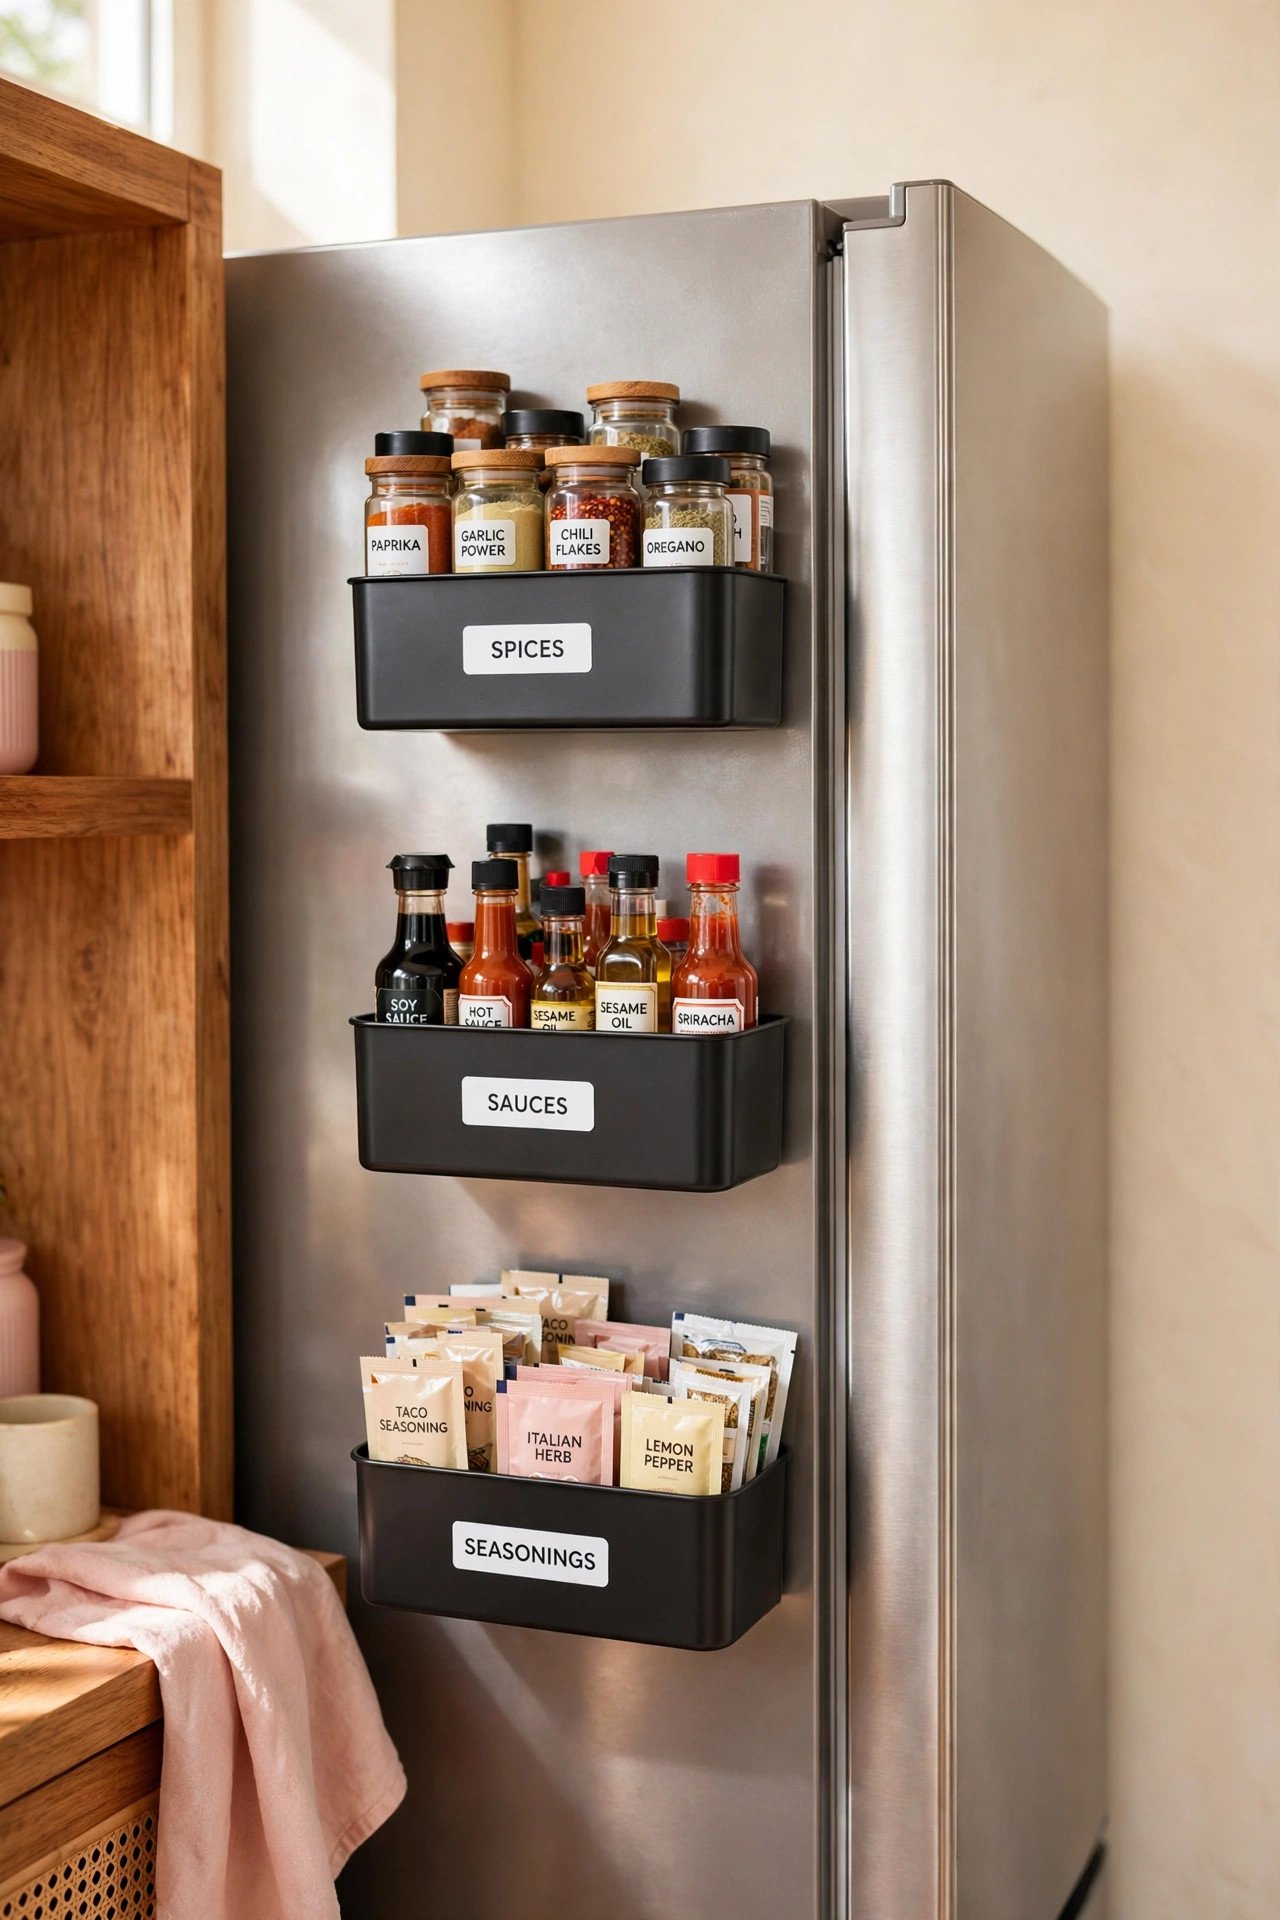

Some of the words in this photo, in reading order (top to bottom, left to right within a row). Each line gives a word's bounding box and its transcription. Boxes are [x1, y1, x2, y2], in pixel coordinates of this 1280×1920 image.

[461, 529, 505, 542] GARLIC
[561, 528, 593, 541] CHILI
[371, 539, 421, 551] PAPRIKA
[461, 545, 506, 557] POWER
[556, 543, 601, 556] FLAKES
[646, 540, 705, 553] OREGANO
[491, 639, 564, 659] SPICES
[390, 999, 417, 1011] SOY
[600, 1001, 647, 1015] SESAME
[469, 1007, 494, 1018] HOT
[534, 1010, 576, 1022] SESAME
[677, 1012, 735, 1026] SRIRACHA
[611, 1017, 632, 1029] OIL
[488, 1093, 568, 1115] SAUCES
[541, 1317, 568, 1330] ACO
[395, 1406, 428, 1418] TACO
[380, 1419, 448, 1433] SEASONING
[527, 1431, 582, 1448] ITALIAN
[646, 1438, 694, 1457] LEMON
[535, 1448, 572, 1463] HERB
[644, 1454, 693, 1473] PEPPER
[464, 1537, 596, 1570] SEASONINGS
